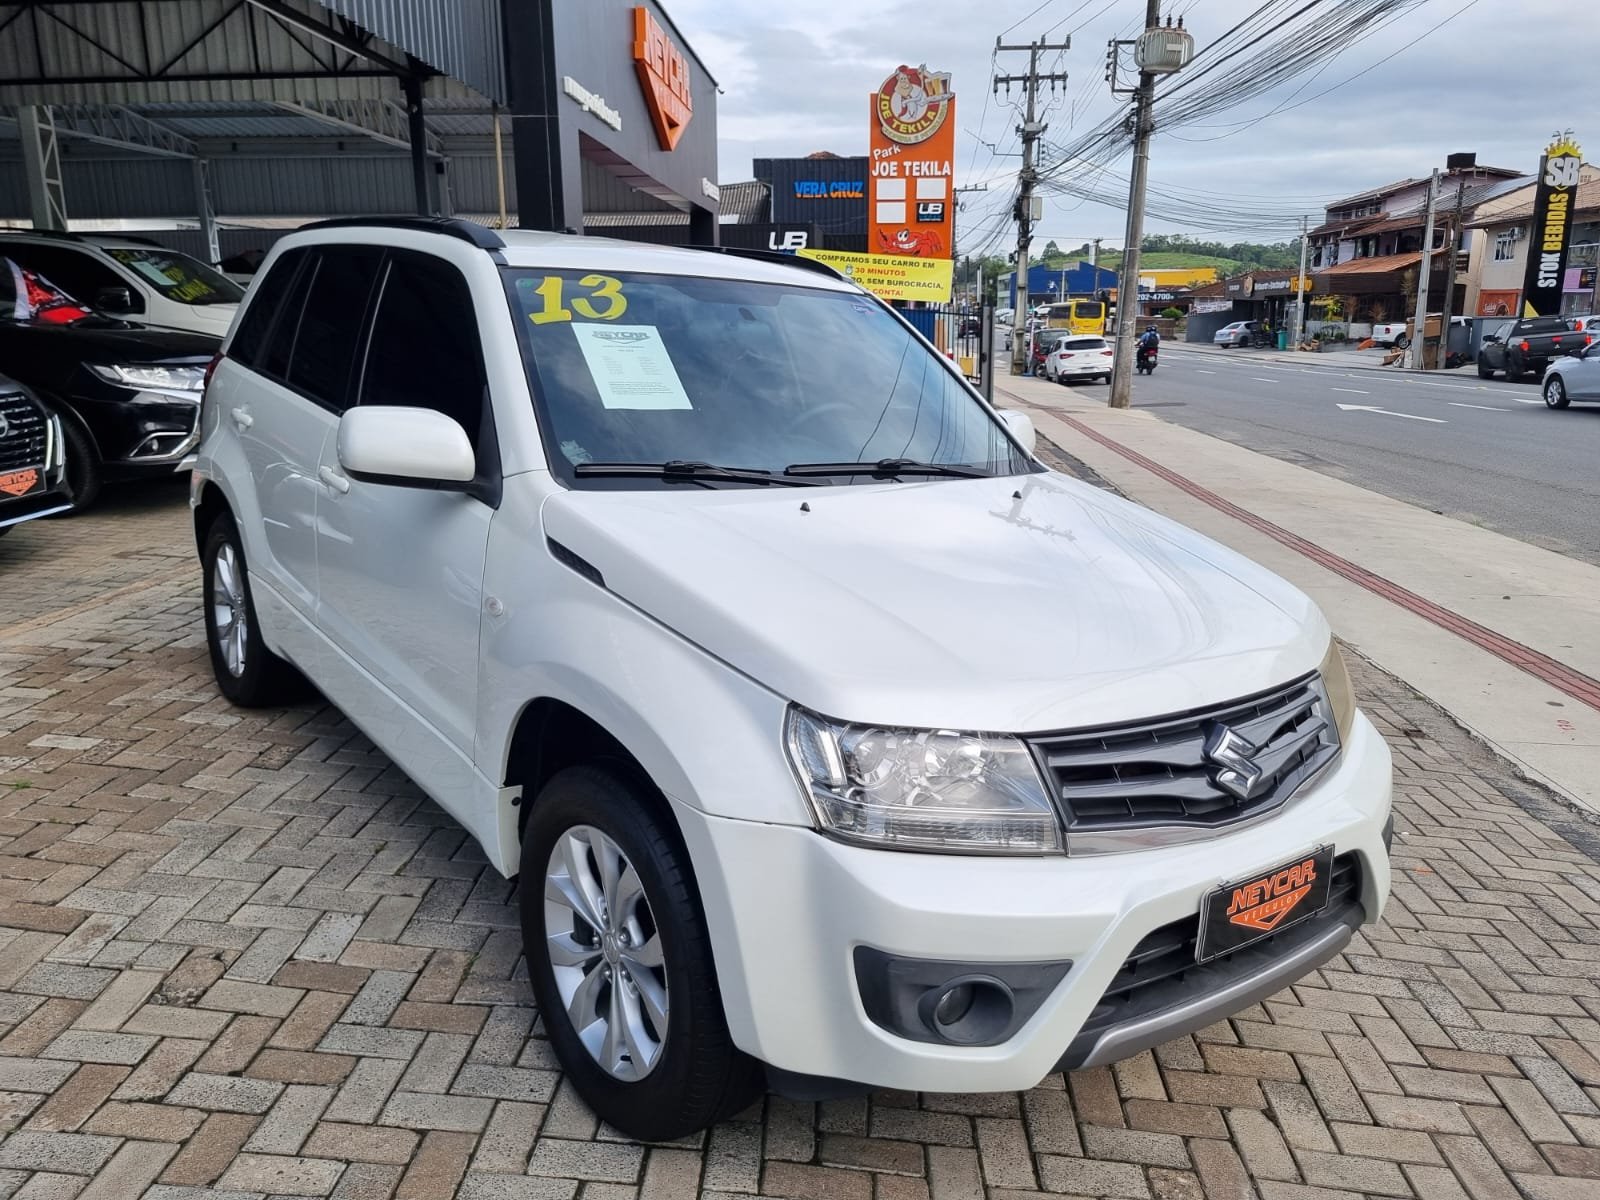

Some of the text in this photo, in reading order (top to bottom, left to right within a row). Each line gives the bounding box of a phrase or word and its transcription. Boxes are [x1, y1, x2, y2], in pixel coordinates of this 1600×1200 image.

[881, 93, 893, 120] JOE
[890, 110, 936, 133] TEKILA
[873, 144, 901, 161] Park
[872, 161, 951, 177] JOE TEKILA
[1545, 157, 1579, 187] SB
[794, 181, 864, 198] VERA CRUZ
[769, 231, 808, 250] UB
[1537, 193, 1569, 288] STOK BEBIDAS
[815, 254, 935, 269] COMPRAMOS SEU CARRO EM
[867, 268, 906, 277] MINUTOS
[887, 279, 944, 289] BUROCRACIA,
[528, 274, 627, 324] 13
[872, 289, 904, 297] CONTA!
[1226, 859, 1317, 916] NEYCAR
